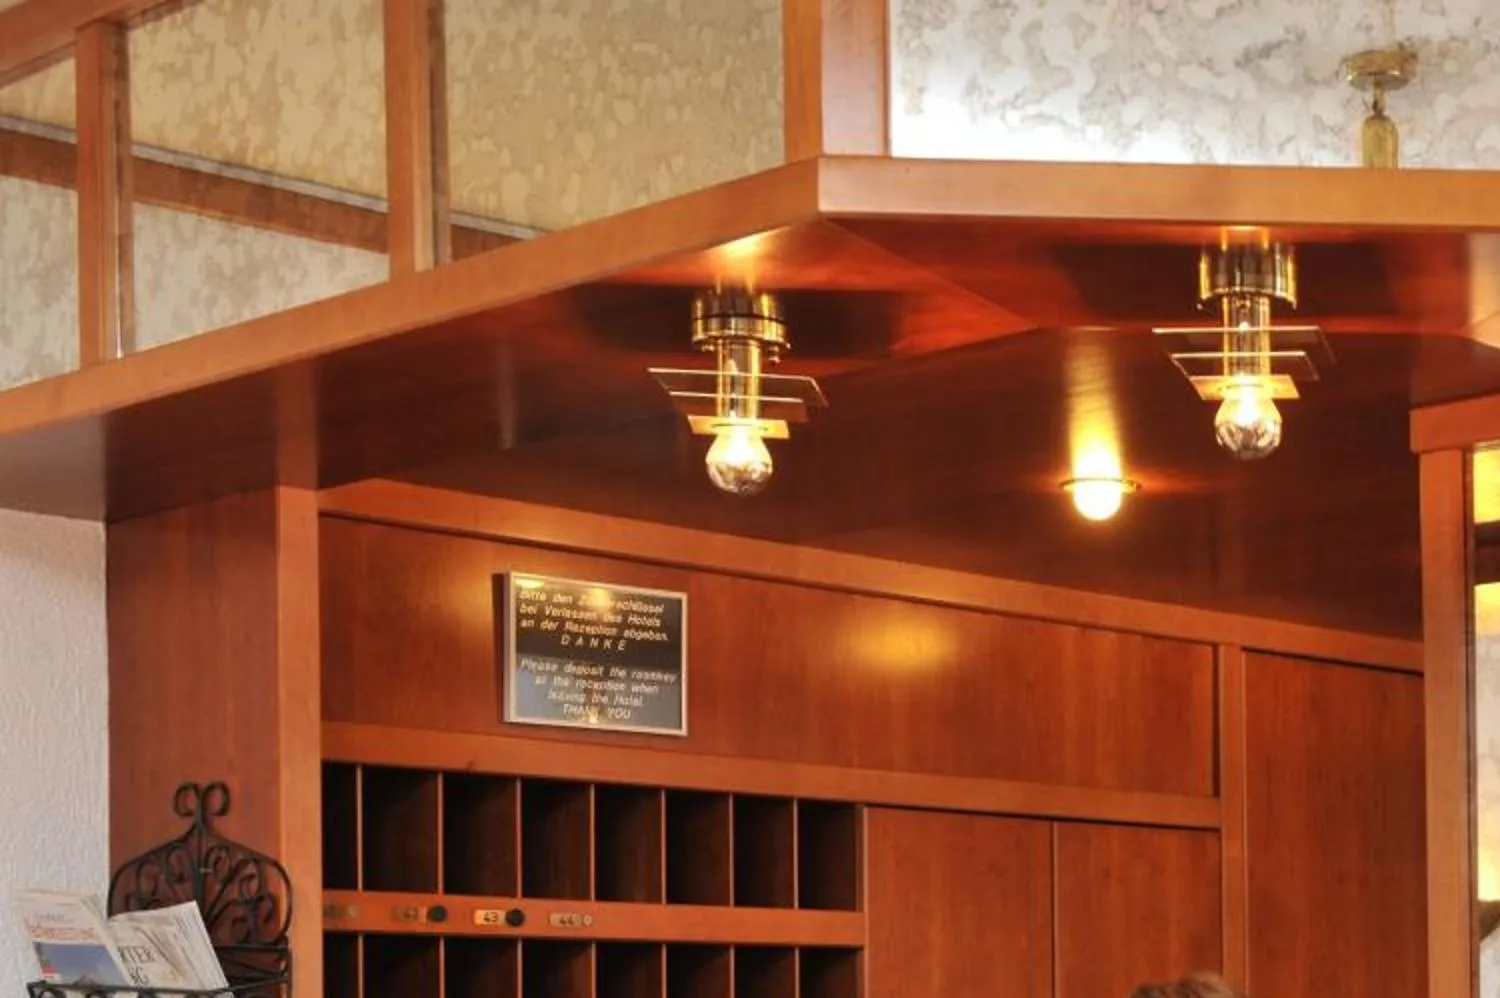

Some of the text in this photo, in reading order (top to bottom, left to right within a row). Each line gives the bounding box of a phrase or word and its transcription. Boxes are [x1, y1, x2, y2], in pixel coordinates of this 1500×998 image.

[519, 603, 537, 615] bei
[627, 614, 661, 627] Hotels
[520, 620, 535, 628] an
[540, 620, 560, 632] der
[521, 657, 558, 671] Please
[609, 667, 627, 677] the
[553, 675, 570, 686] the
[607, 707, 631, 719] YOU
